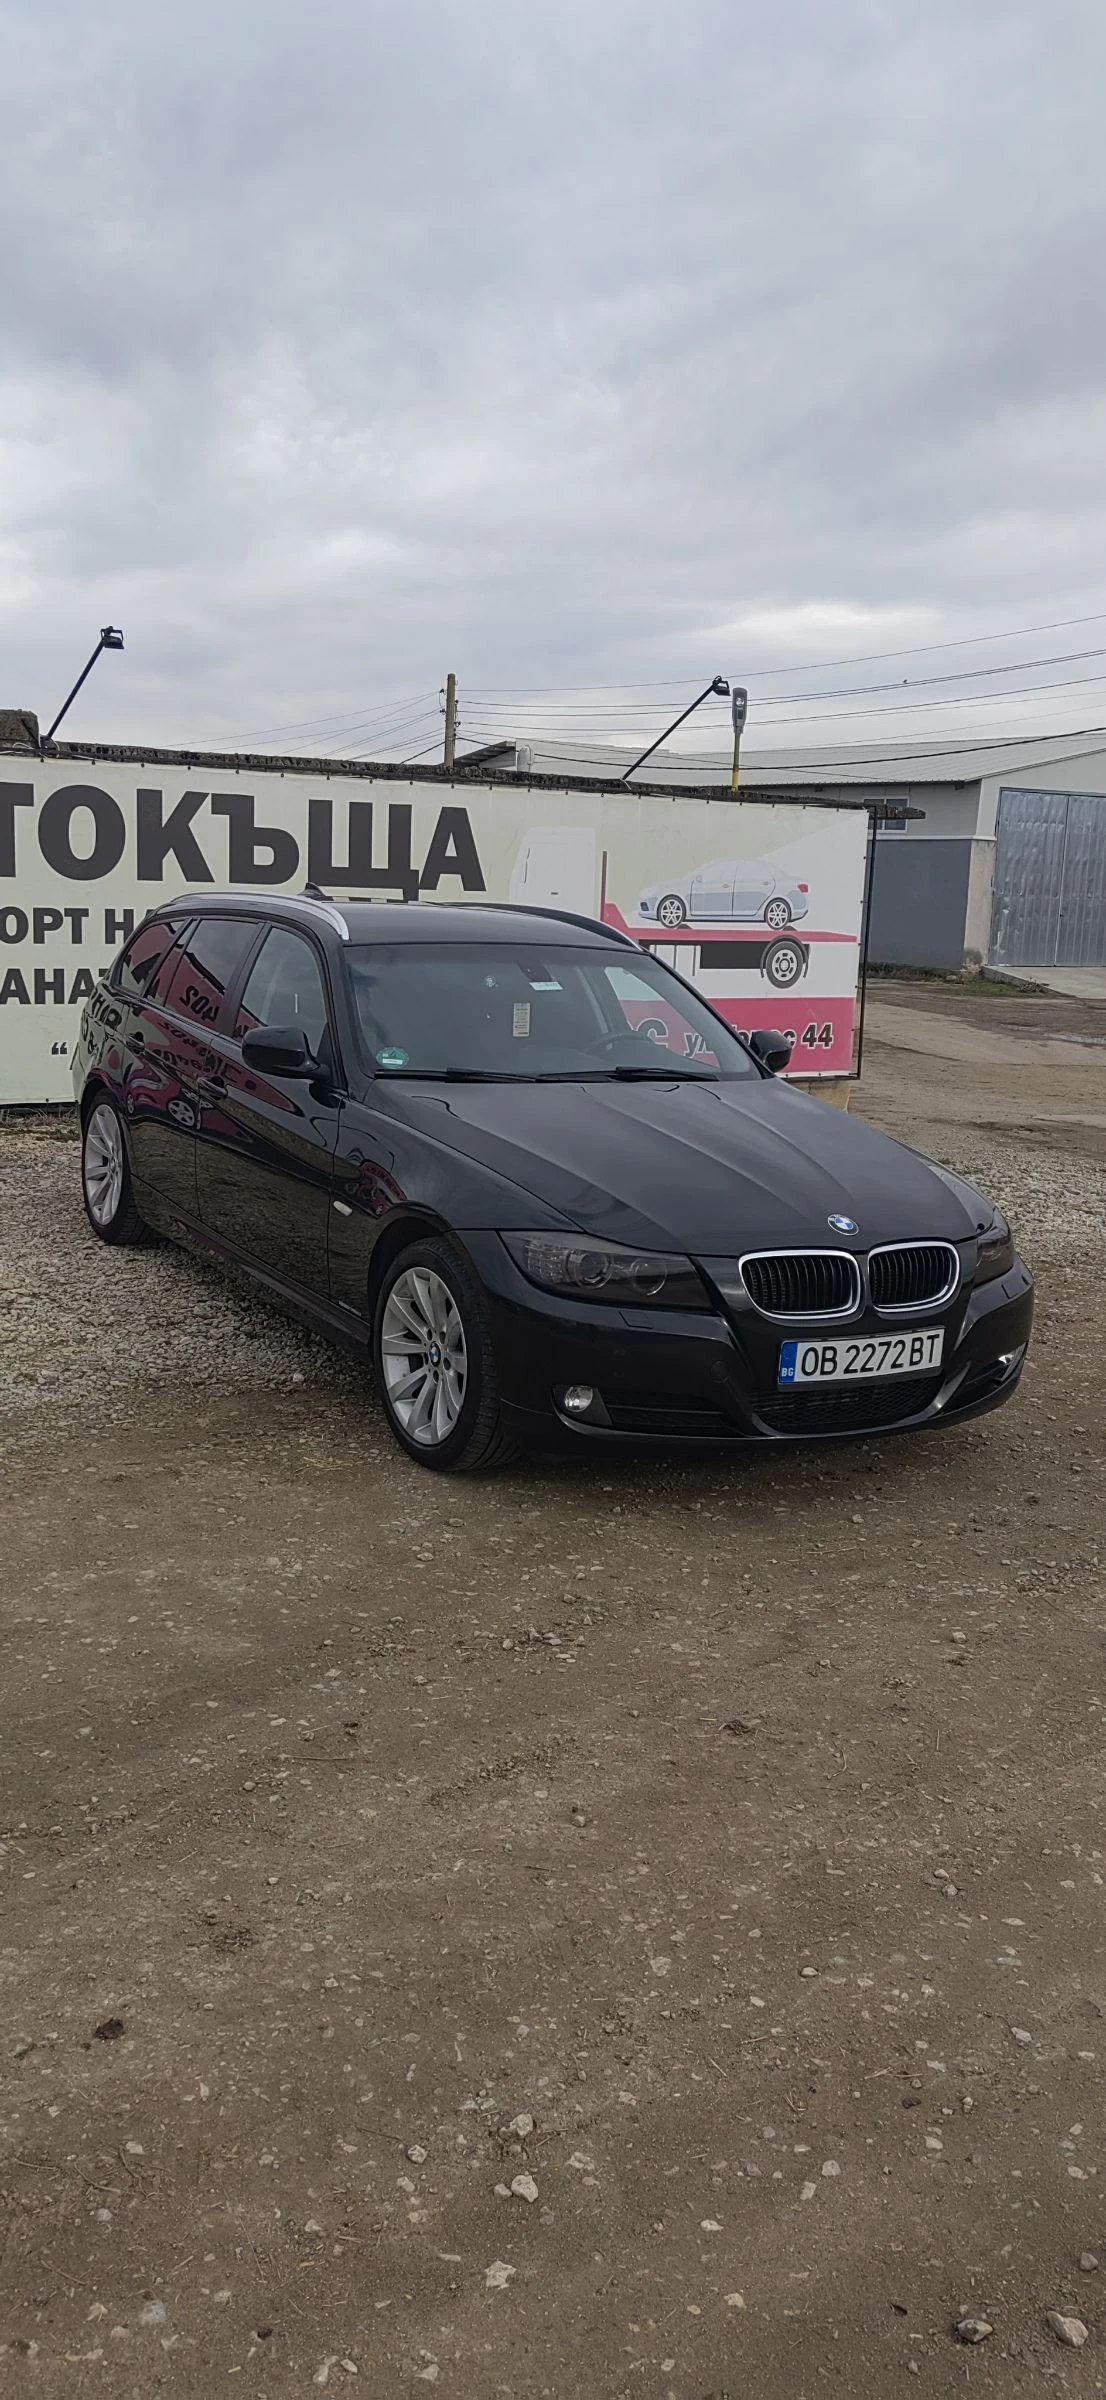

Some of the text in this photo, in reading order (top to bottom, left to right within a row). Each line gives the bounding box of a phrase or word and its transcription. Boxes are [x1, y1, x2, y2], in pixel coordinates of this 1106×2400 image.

[0, 906, 89, 944] ОРТ
[0, 968, 107, 1005] АНА
[801, 1022, 833, 1049] 44
[781, 1367, 794, 1377] BG
[801, 1334, 940, 1377] OB 2272 BT
